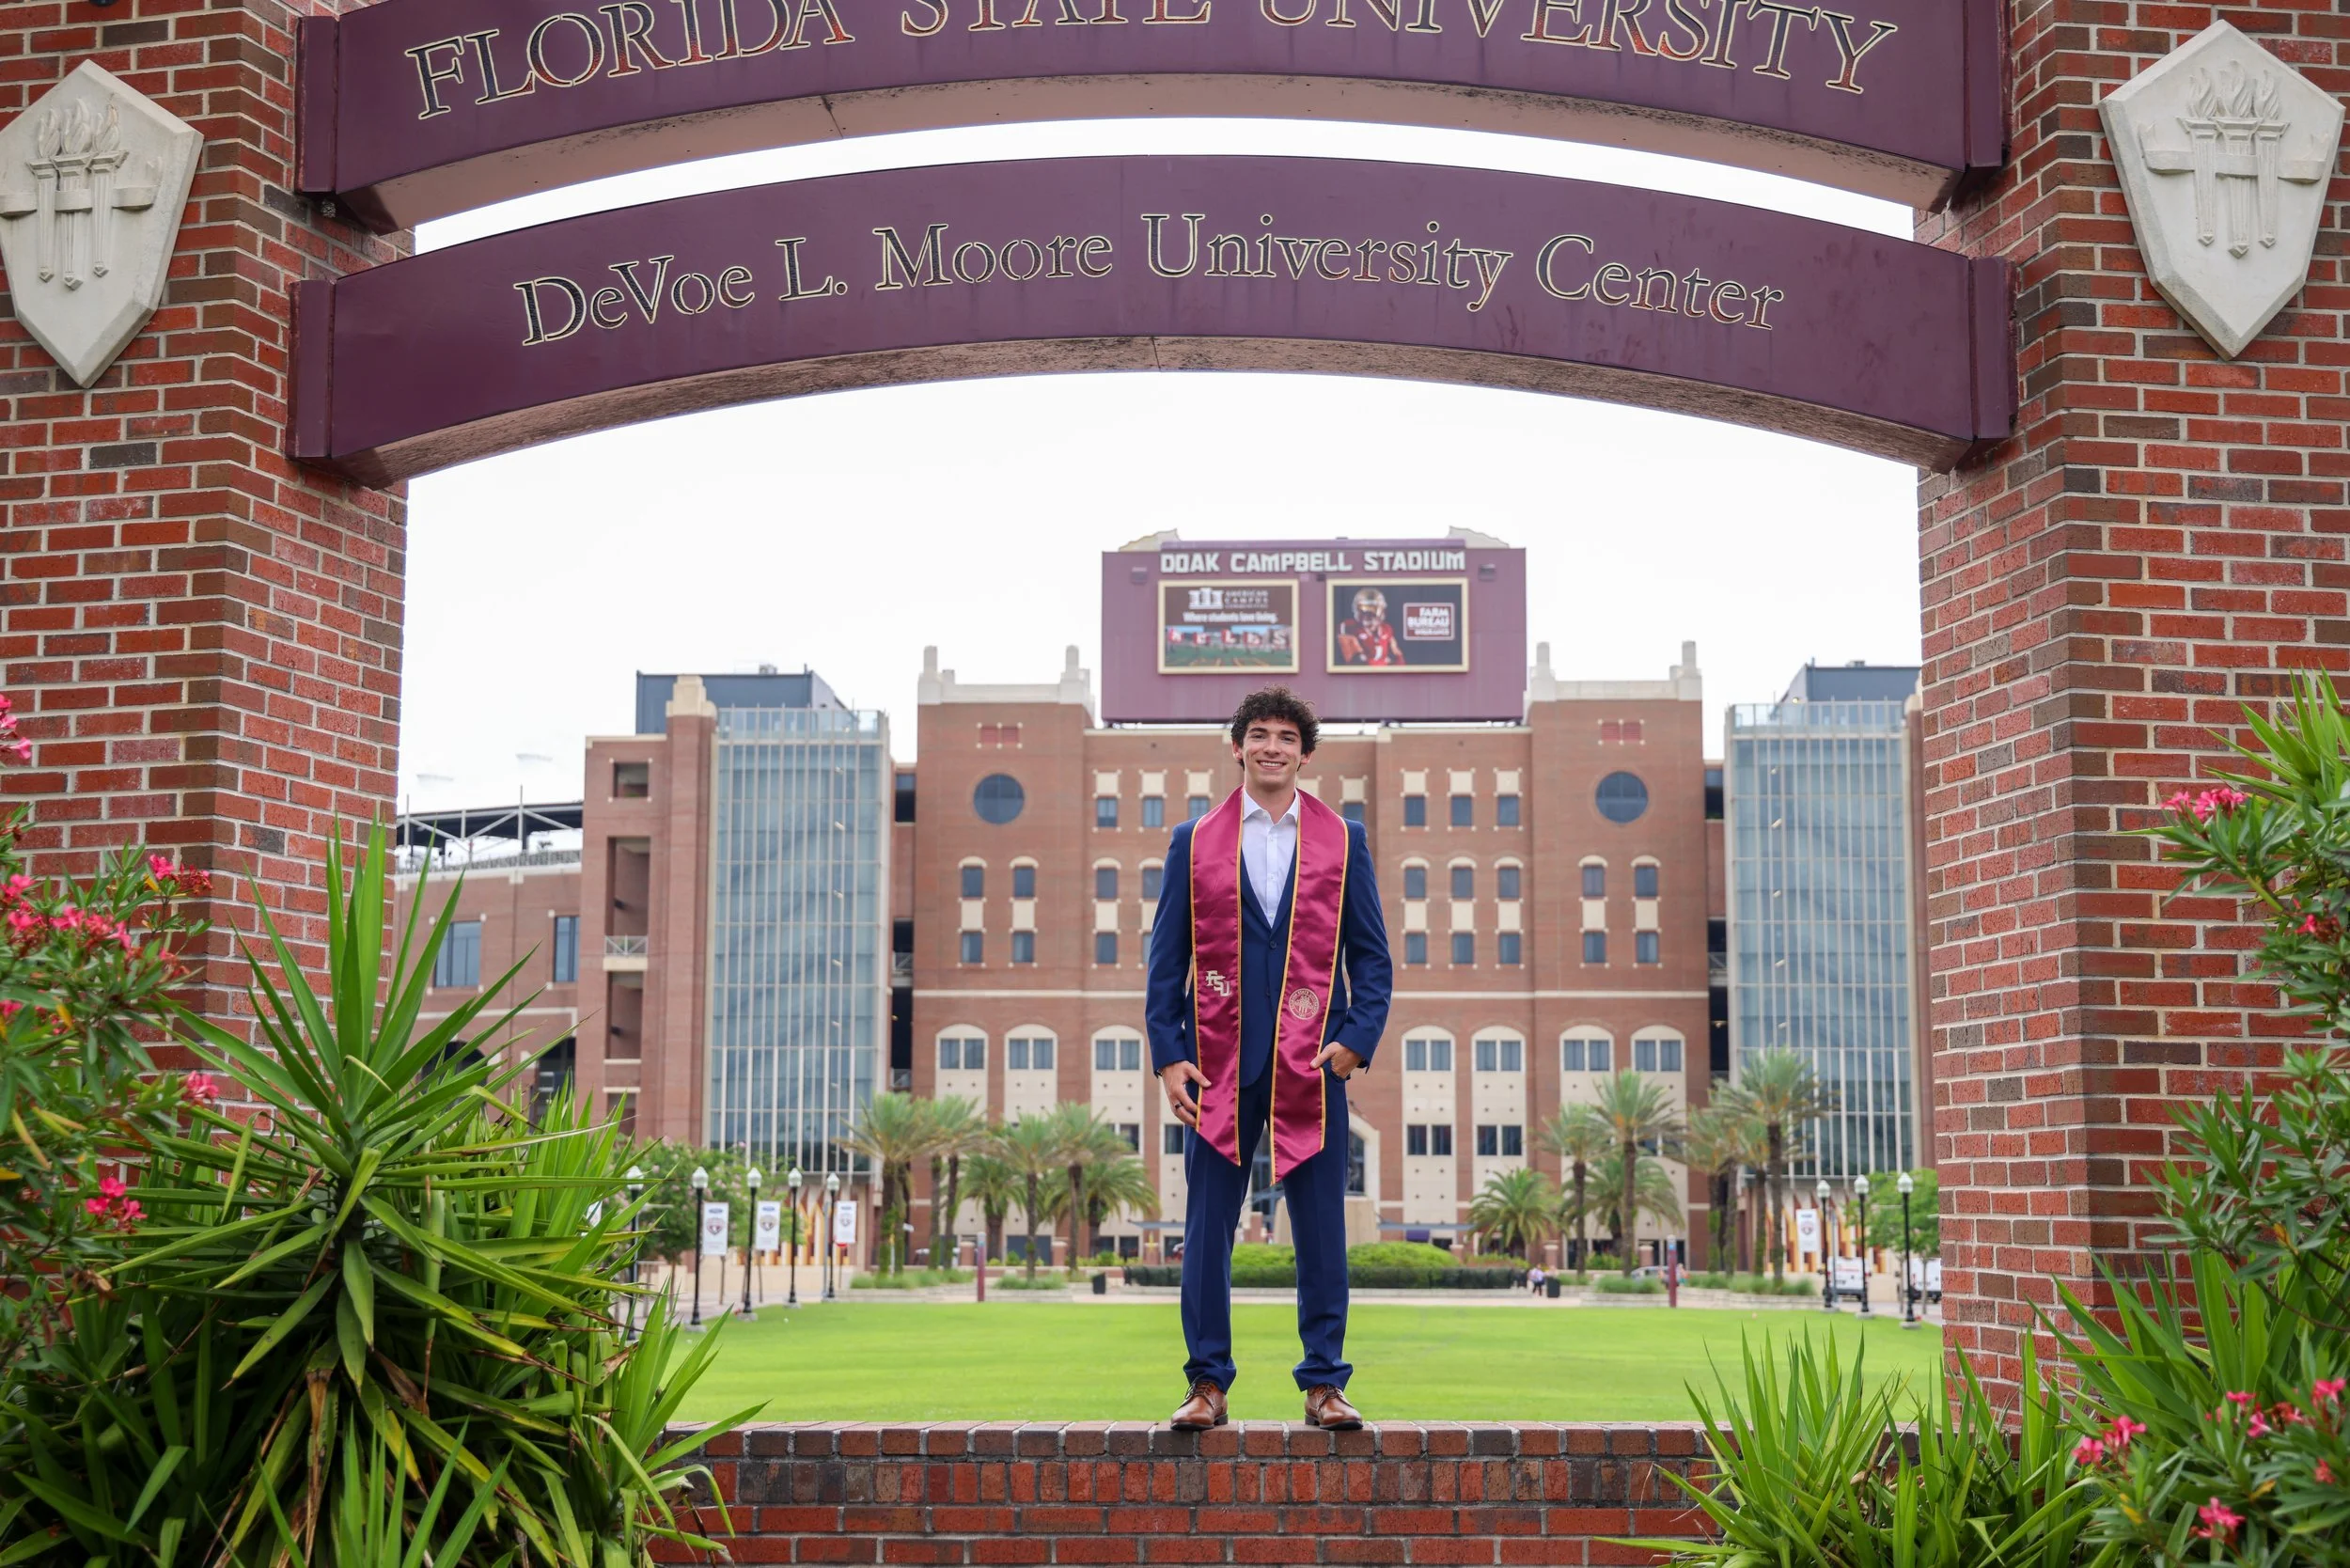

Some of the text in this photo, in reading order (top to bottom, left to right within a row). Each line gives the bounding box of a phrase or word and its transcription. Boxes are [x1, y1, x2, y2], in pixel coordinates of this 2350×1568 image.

[404, 0, 855, 119] FLORIDA
[513, 212, 1784, 346] DeVoe L. Moore University Center
[1160, 550, 1466, 573] DOAK CAMPBELL STADIUM
[1407, 617, 1450, 627] BUREAU
[1419, 606, 1449, 617] FARM
[1205, 969, 1232, 996] FSU
